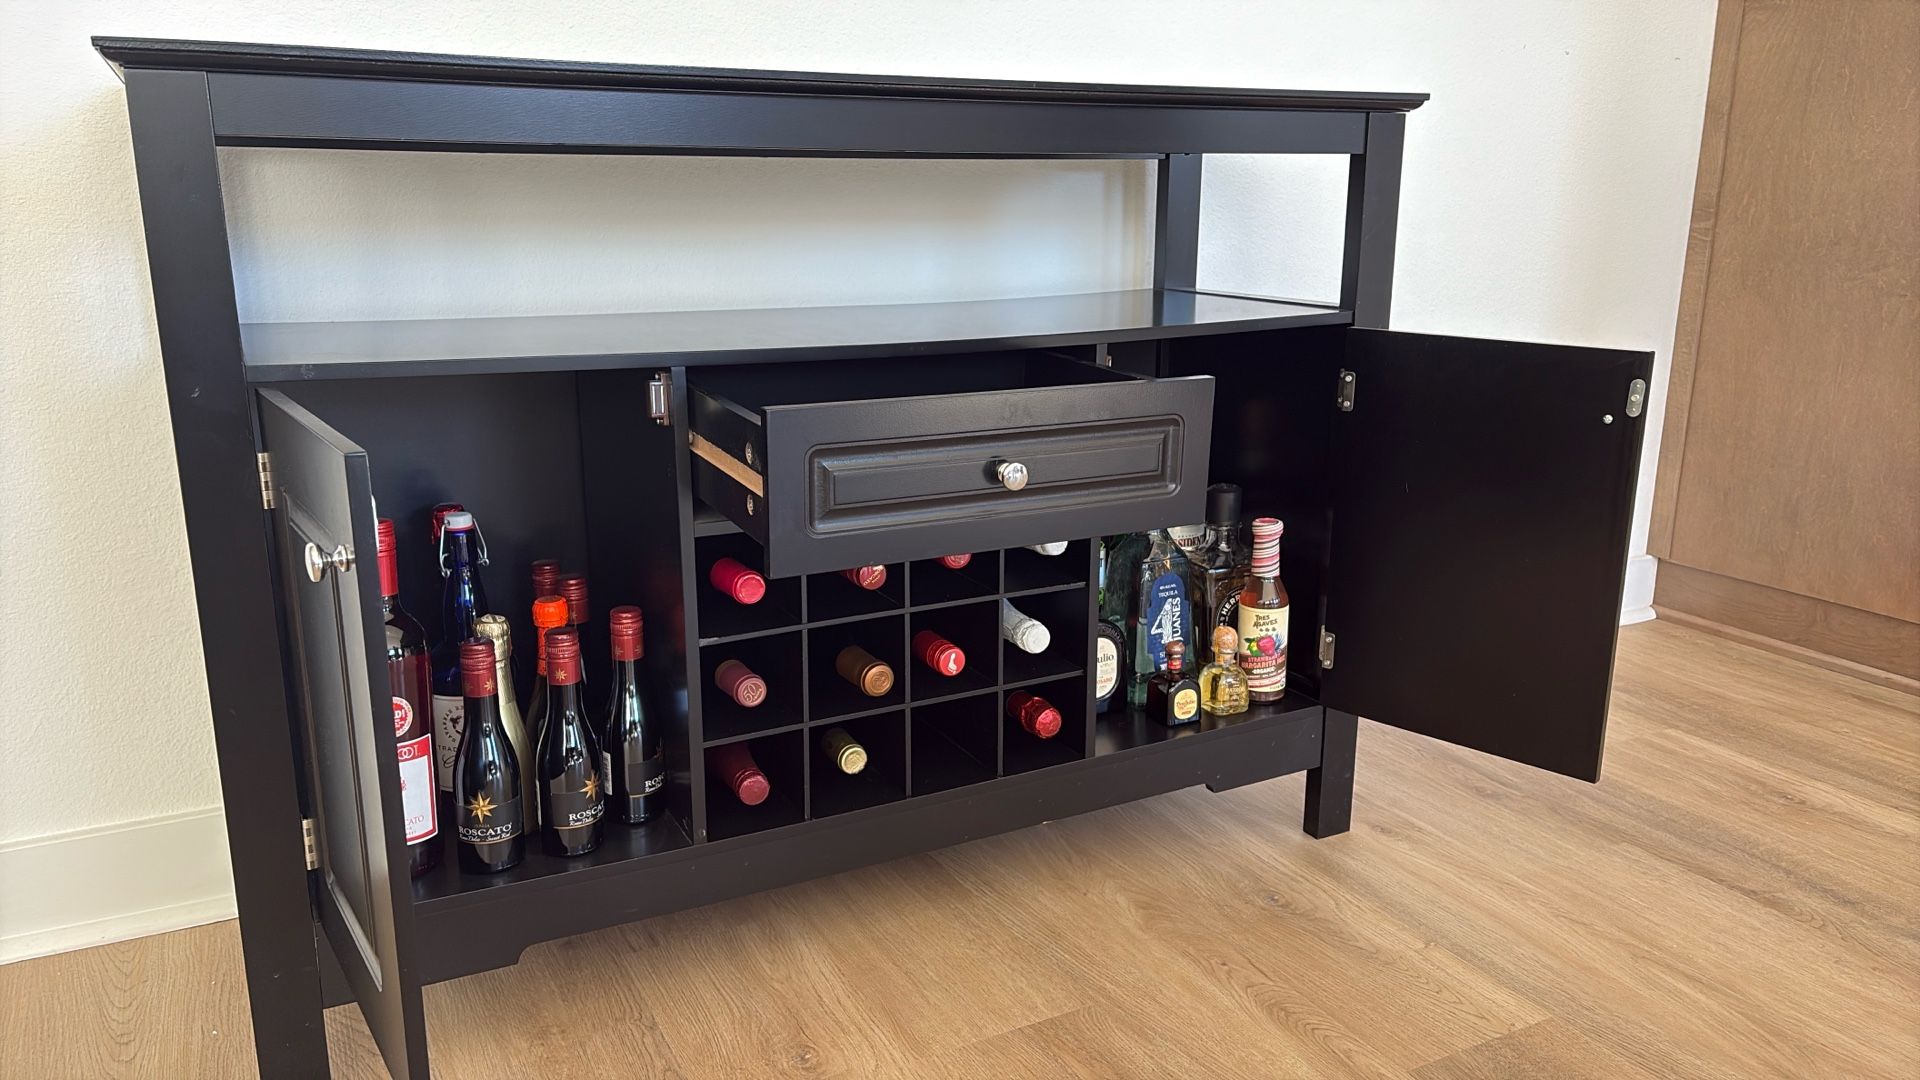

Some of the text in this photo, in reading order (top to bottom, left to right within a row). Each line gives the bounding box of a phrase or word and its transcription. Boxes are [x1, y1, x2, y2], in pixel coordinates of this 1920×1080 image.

[1158, 590, 1179, 598] TEQUILA
[1172, 596, 1184, 641] JUANES
[1252, 618, 1278, 629] AGAVES
[1096, 653, 1114, 664] ulio
[458, 823, 512, 837] ROSCATO
